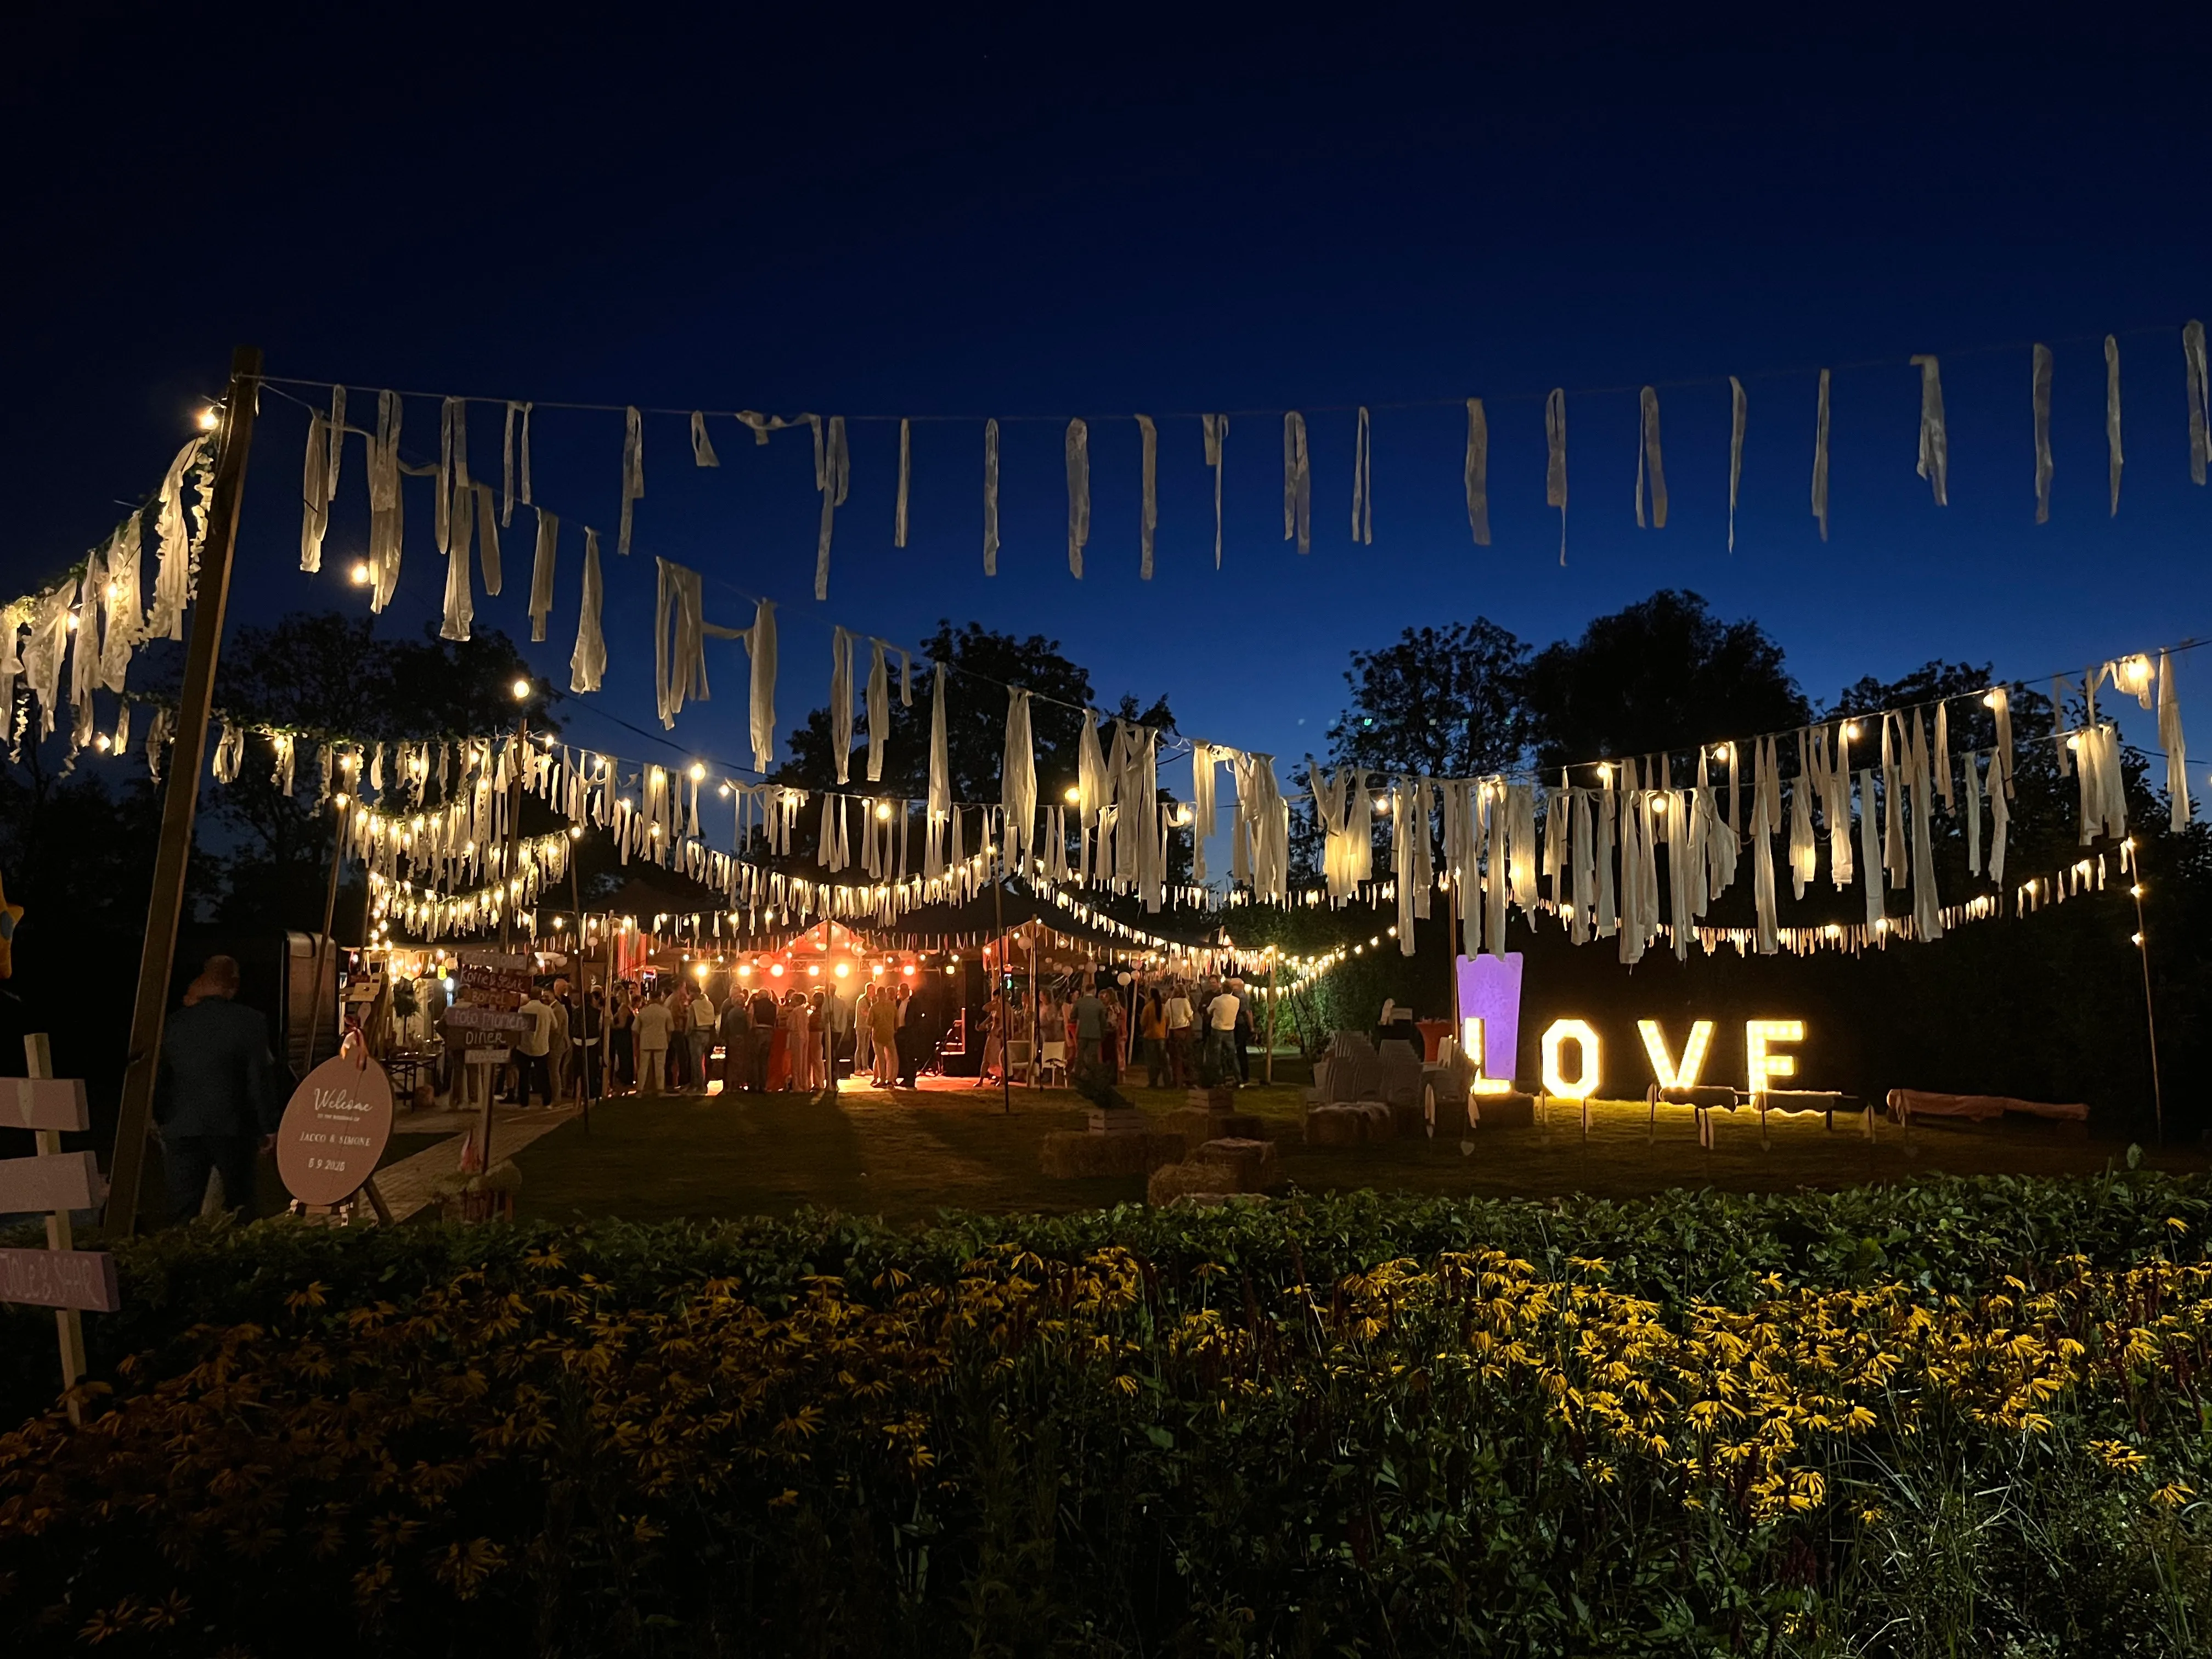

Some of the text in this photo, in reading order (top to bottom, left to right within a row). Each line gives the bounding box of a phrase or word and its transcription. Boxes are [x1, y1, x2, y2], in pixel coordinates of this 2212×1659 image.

[1464, 1017, 1805, 1104] LOVE
[314, 1087, 374, 1112] Welcome
[299, 1131, 371, 1147] JACCO & SIMONE
